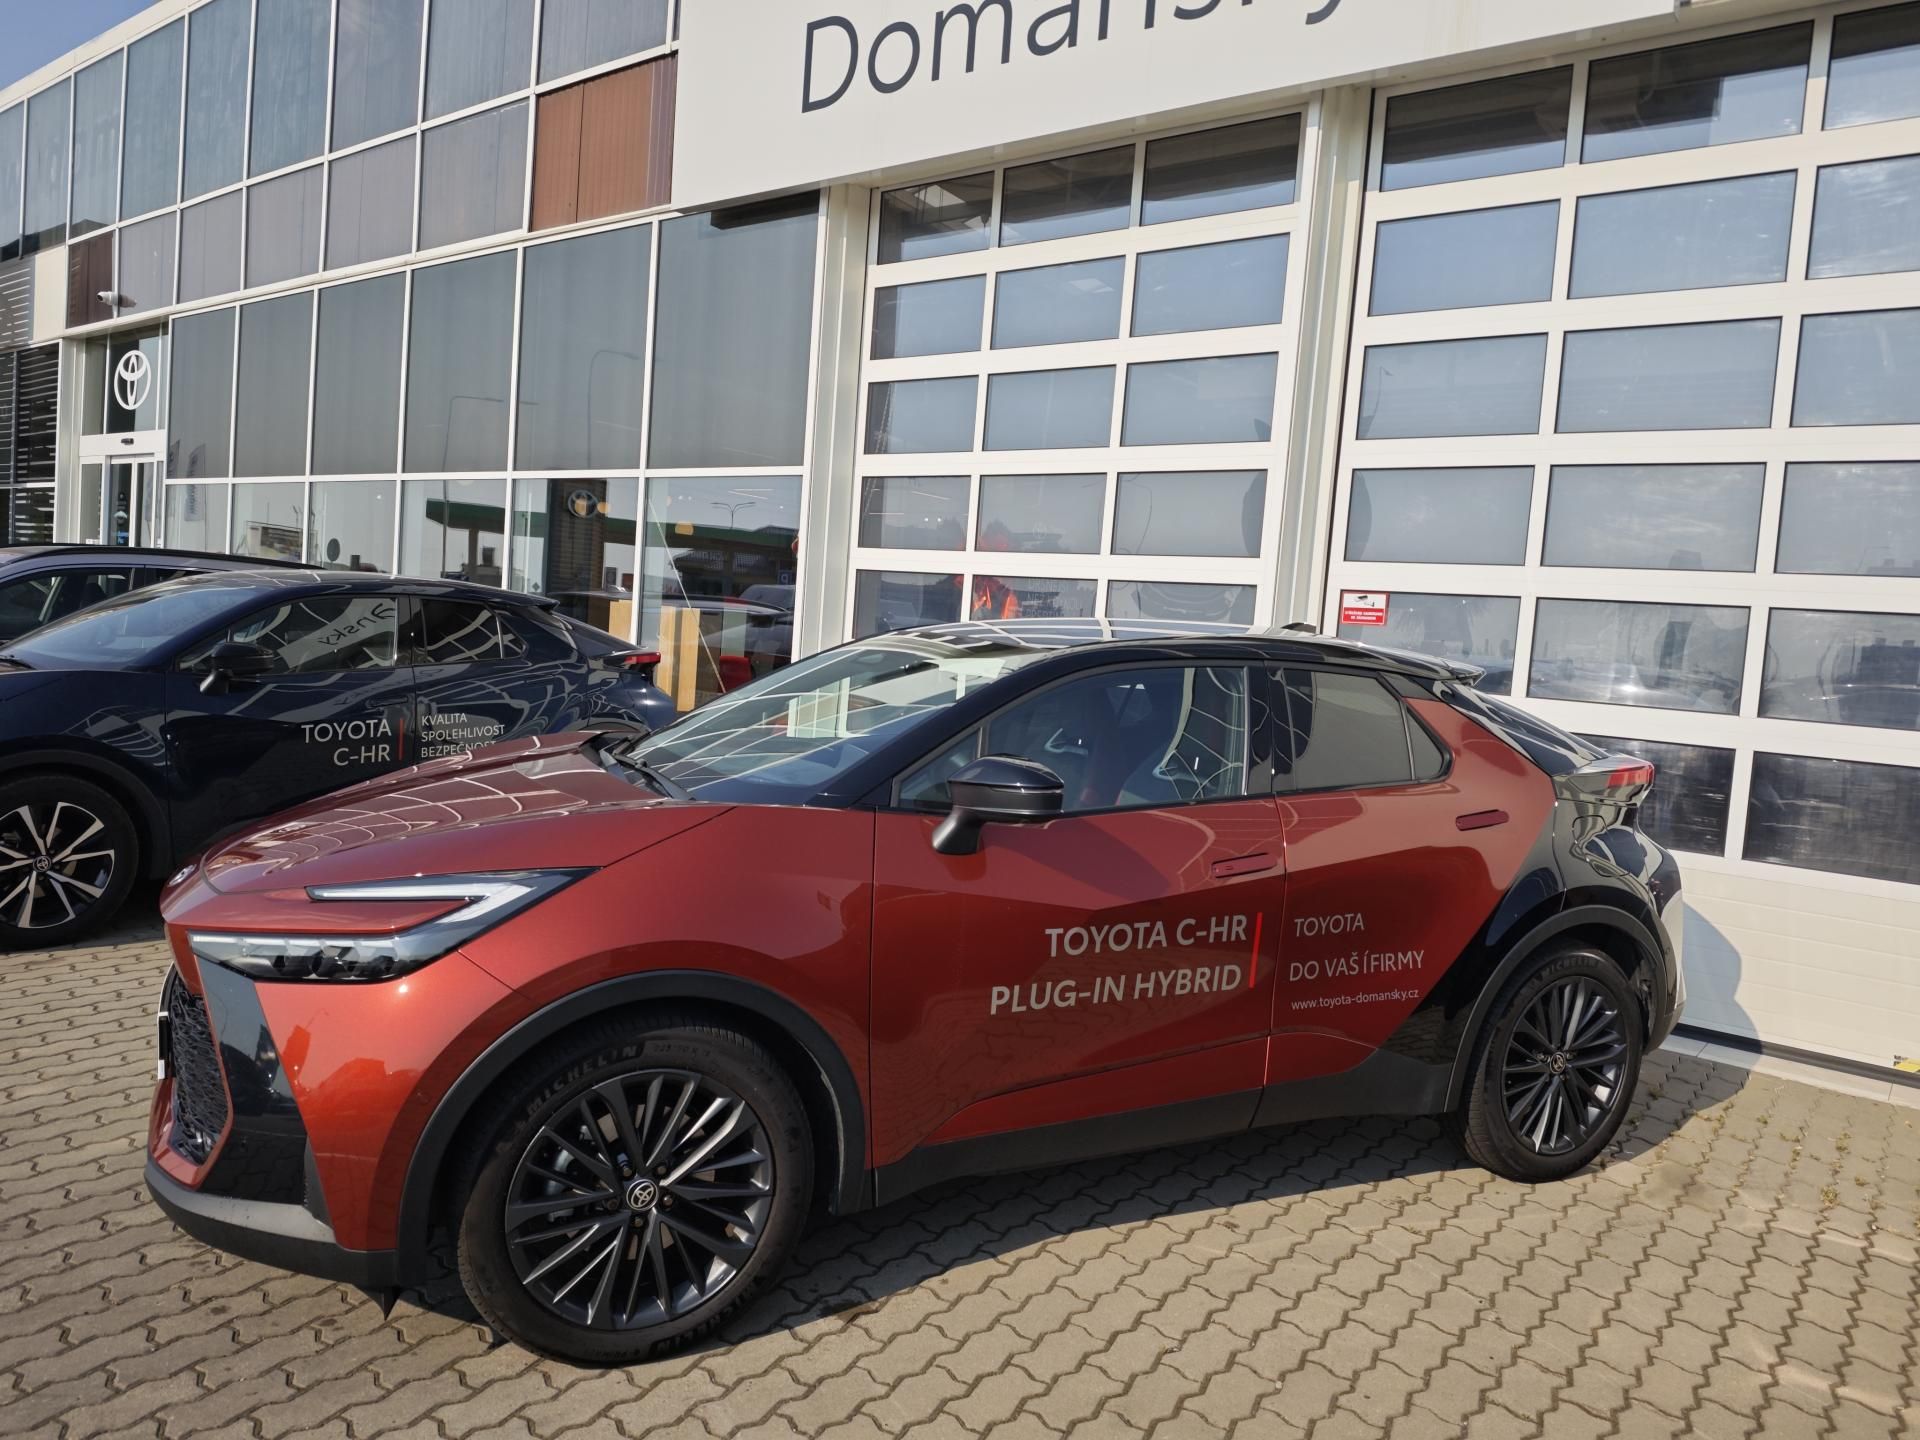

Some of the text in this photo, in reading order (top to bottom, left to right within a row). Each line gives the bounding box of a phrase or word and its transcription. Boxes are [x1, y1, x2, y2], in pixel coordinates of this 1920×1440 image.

[801, 0, 1342, 114] Doma
[301, 718, 392, 744] TOYOTA
[421, 712, 468, 726] KVALITA
[421, 724, 505, 742] SPOLEHLIVOST
[333, 744, 391, 766] C-HR
[1045, 914, 1248, 957] TOYOTA C-HR
[1294, 913, 1365, 937] TOYOTA
[1289, 960, 1320, 982] DO
[990, 964, 1242, 1016] PLUG-IN HYBRID
[1291, 988, 1419, 1011] www.toyota-domansky.cz
[525, 1045, 638, 1117] MICHELIN
